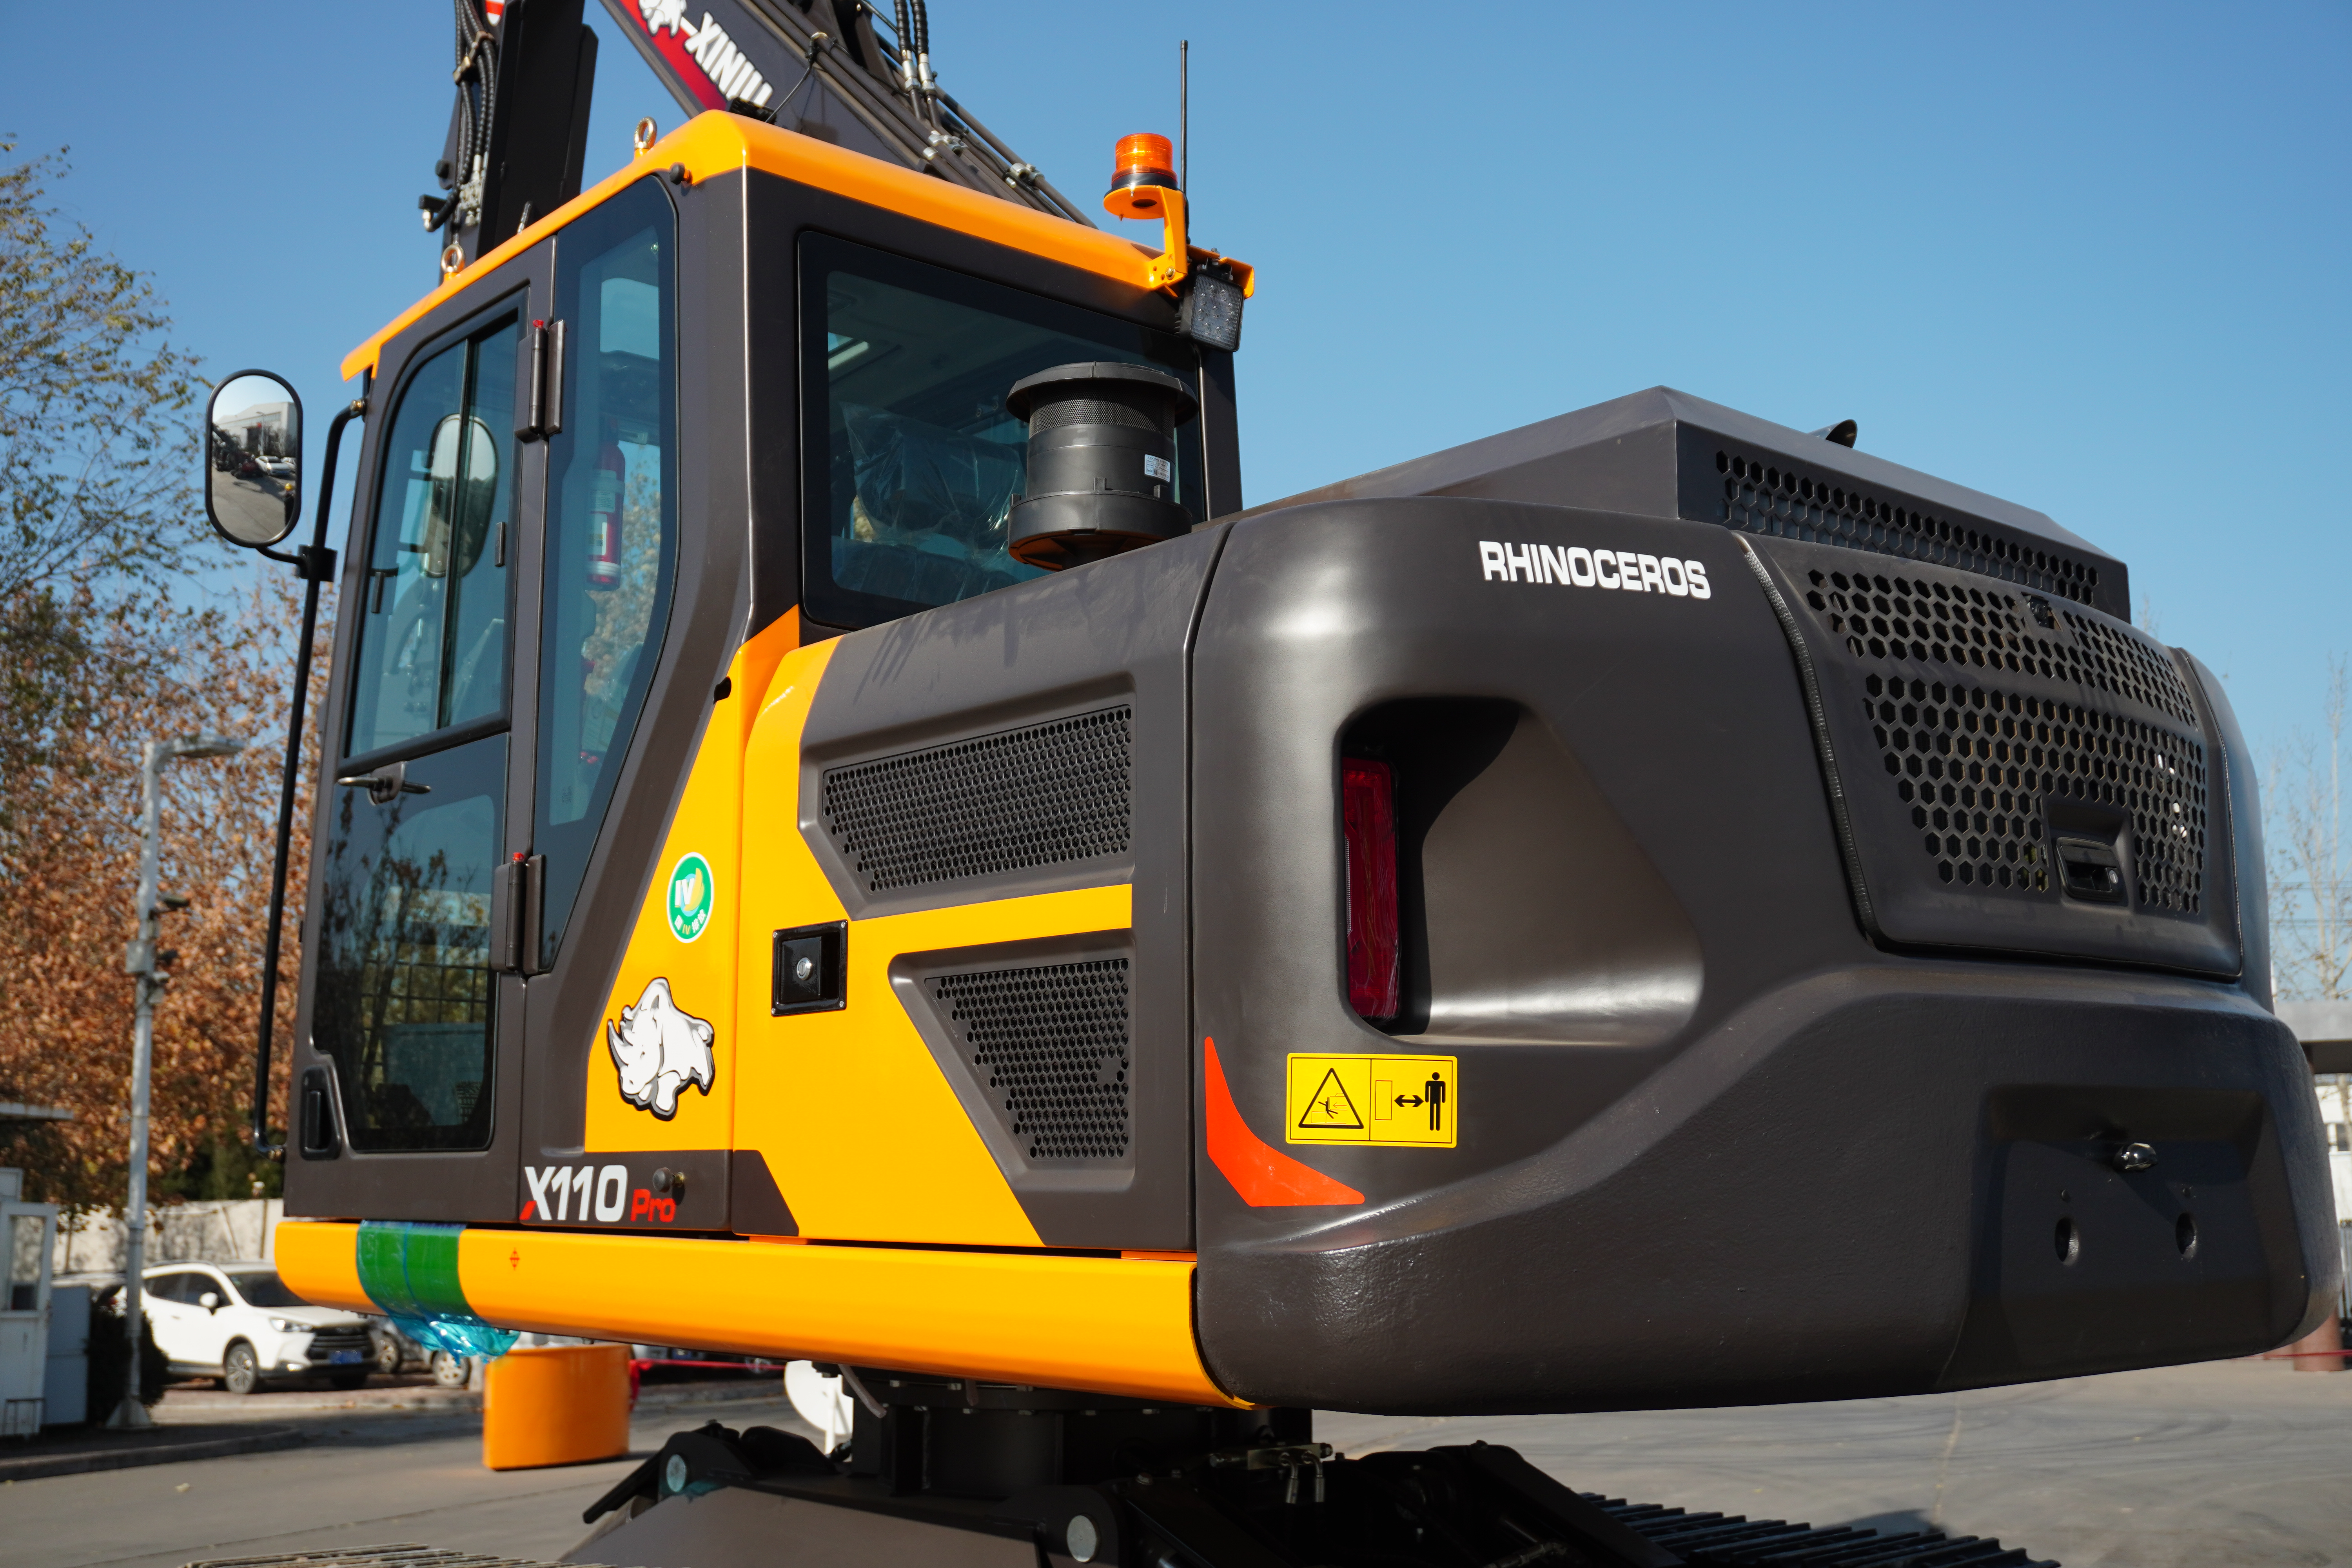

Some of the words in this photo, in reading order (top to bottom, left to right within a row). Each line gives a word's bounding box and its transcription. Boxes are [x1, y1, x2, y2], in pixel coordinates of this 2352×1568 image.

[1479, 541, 1711, 600] RHINOCEROS
[519, 1165, 628, 1222] X110
[630, 1189, 677, 1223] Pro
